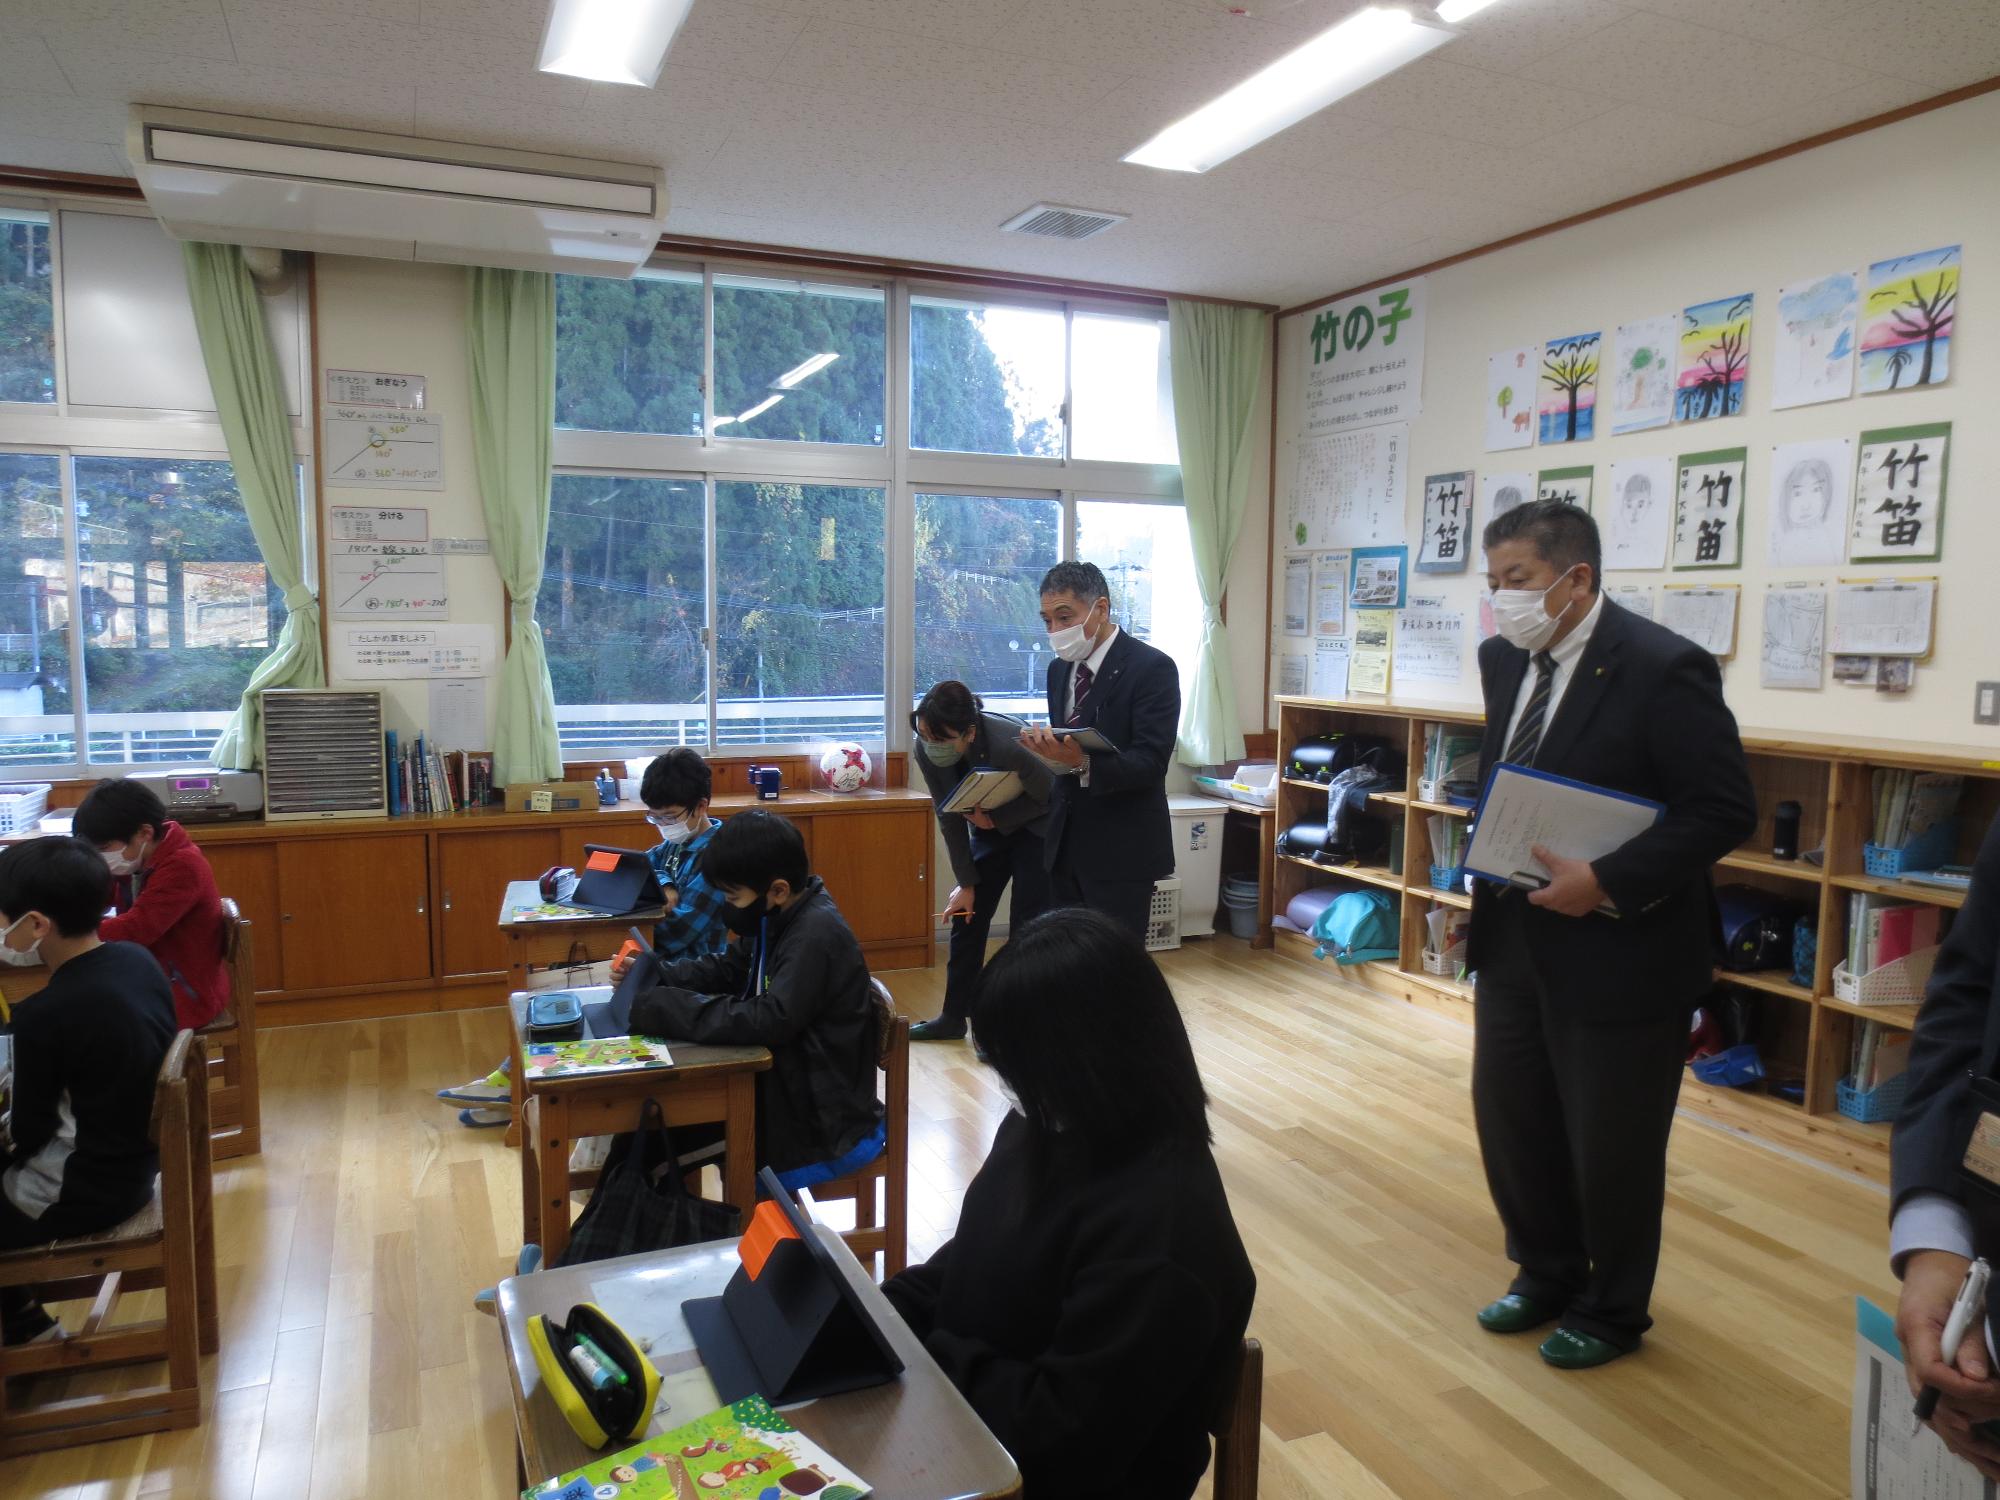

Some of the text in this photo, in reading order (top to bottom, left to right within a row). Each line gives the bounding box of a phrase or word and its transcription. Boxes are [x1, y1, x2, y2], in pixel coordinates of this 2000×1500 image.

[1310, 288, 1413, 365] 竹の子
[378, 511, 404, 520] 分ける
[1433, 482, 1464, 559] 竹笛
[1695, 470, 1733, 562] 竹笛
[1872, 442, 1929, 547] 竹笛
[357, 634, 428, 643] たしかめ算をしよう
